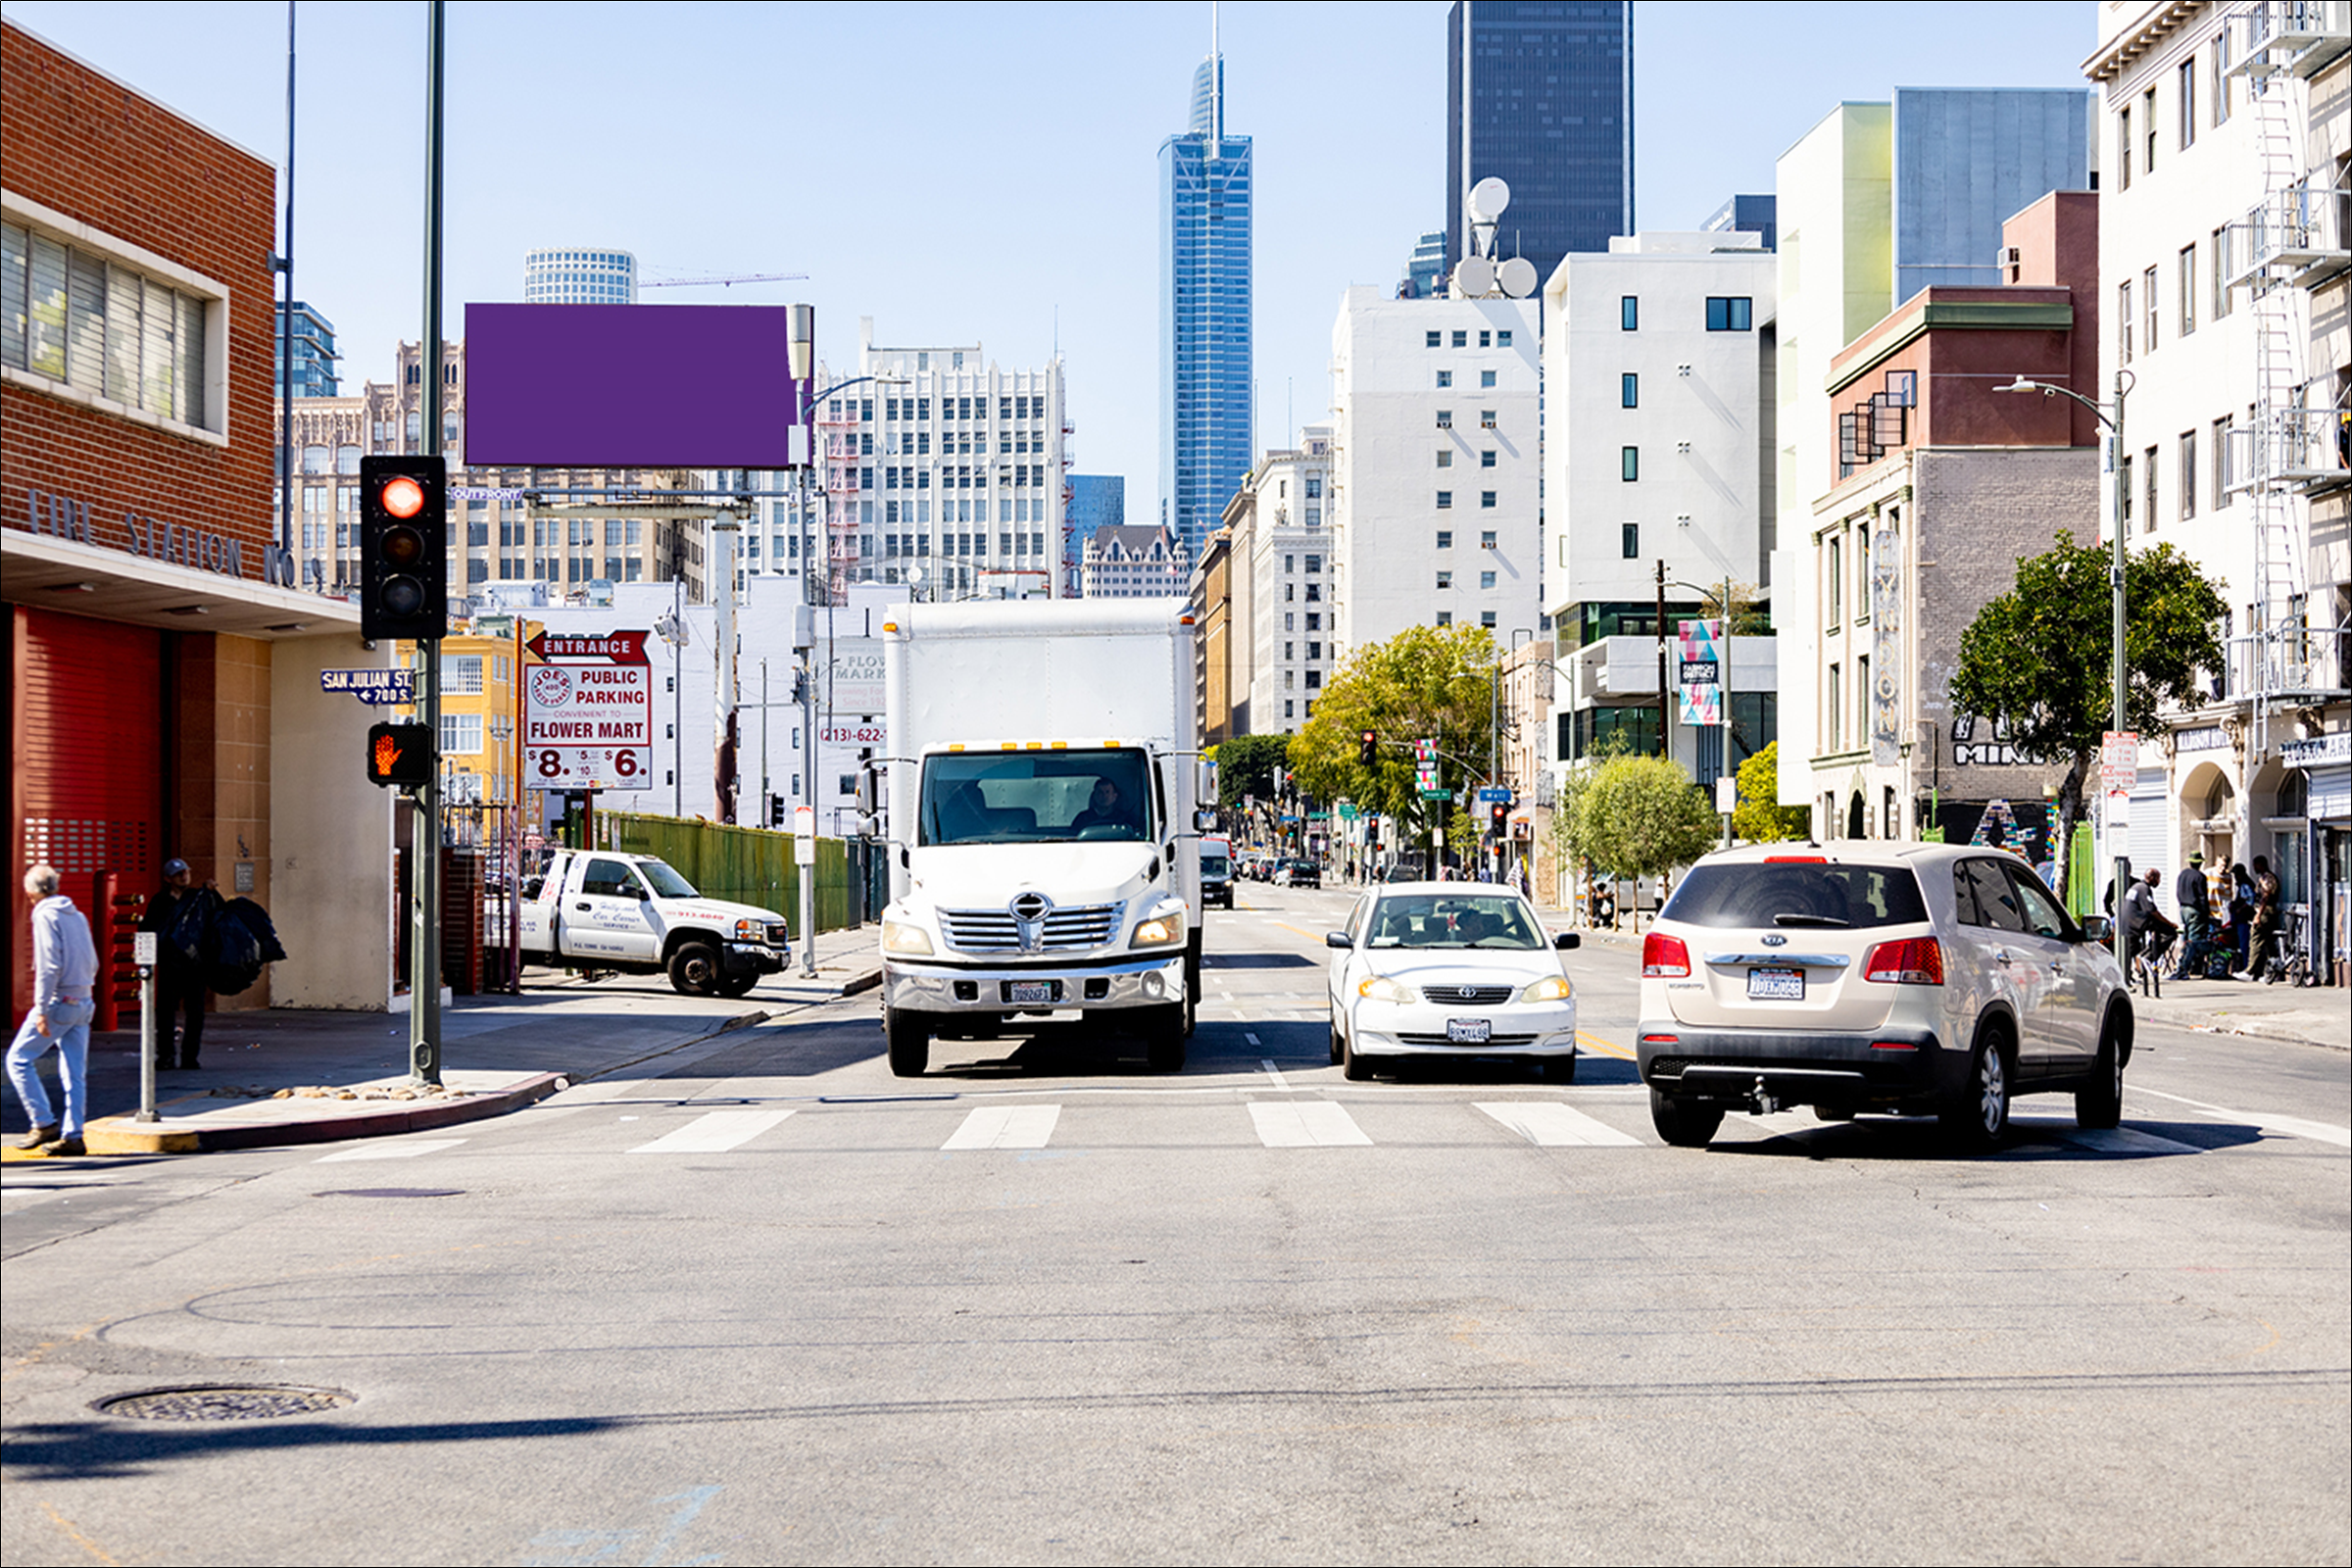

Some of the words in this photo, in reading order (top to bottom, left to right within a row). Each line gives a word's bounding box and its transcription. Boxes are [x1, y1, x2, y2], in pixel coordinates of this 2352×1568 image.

[453, 489, 521, 500] OUTFRONT
[28, 488, 97, 546] FIRE
[126, 513, 242, 578] STATION
[1878, 543, 1895, 732] LYNDON
[544, 640, 630, 654] ENTRANCE
[322, 672, 347, 688] SAN
[349, 672, 390, 688] JULIAN
[581, 670, 638, 684] PUBLIC
[374, 689, 396, 702] 700
[576, 690, 645, 705] PARKING
[553, 710, 607, 718] CONVENIENT
[610, 710, 622, 718] TO
[531, 722, 593, 738] FLOWER
[598, 722, 644, 738] MART
[1764, 935, 1785, 945] KIA
